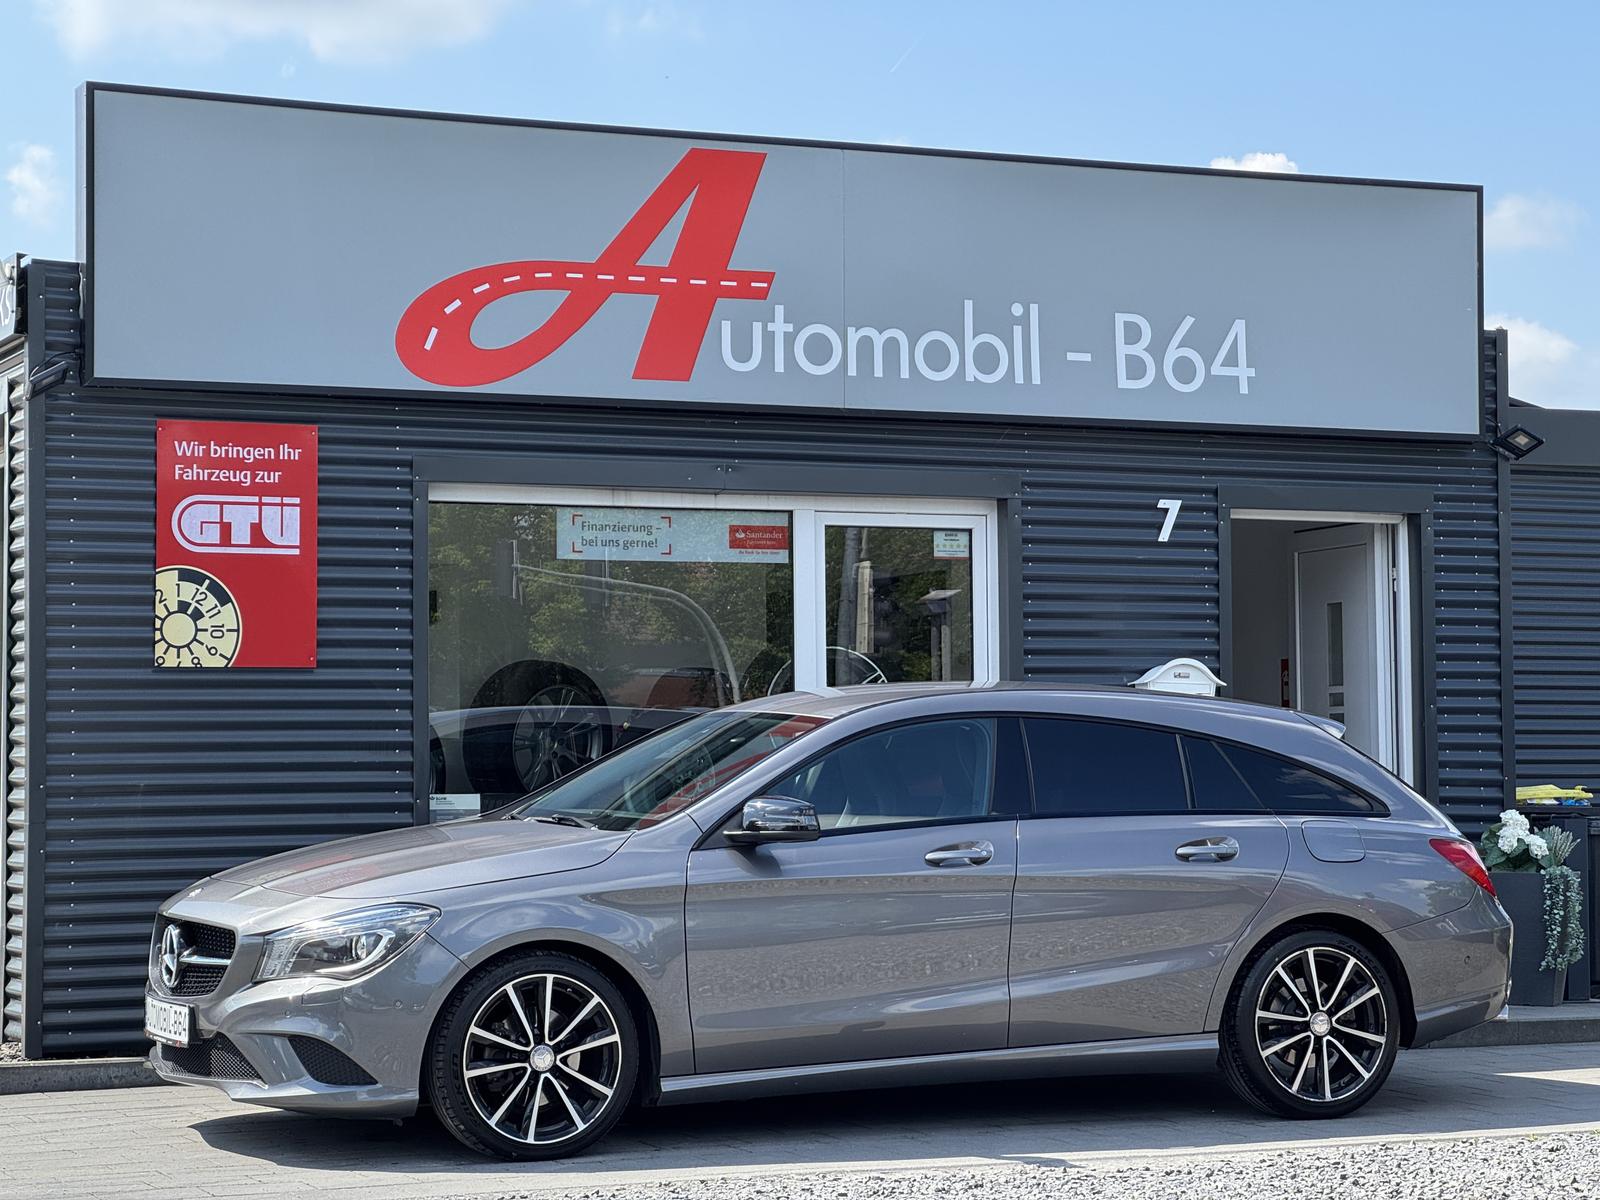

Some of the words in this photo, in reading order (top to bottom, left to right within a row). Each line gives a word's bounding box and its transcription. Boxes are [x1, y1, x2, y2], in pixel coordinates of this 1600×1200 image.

[395, 148, 1041, 388] Automobil
[1066, 351, 1092, 362] -
[1114, 312, 1256, 395] B64
[174, 440, 206, 457] Wir
[210, 441, 274, 463] bringen
[279, 443, 302, 460] Ihr
[174, 464, 250, 486] Fahrzeug
[254, 470, 282, 483] zur
[179, 496, 300, 547] GTÜ
[581, 521, 653, 536] Finanzierung
[1157, 499, 1182, 542] 7
[581, 536, 598, 547] bei
[601, 538, 620, 548] uns
[622, 538, 658, 550] gerne!
[746, 529, 784, 539] Santander
[175, 583, 181, 598] 1
[190, 587, 208, 607] 12
[210, 623, 225, 640] 10
